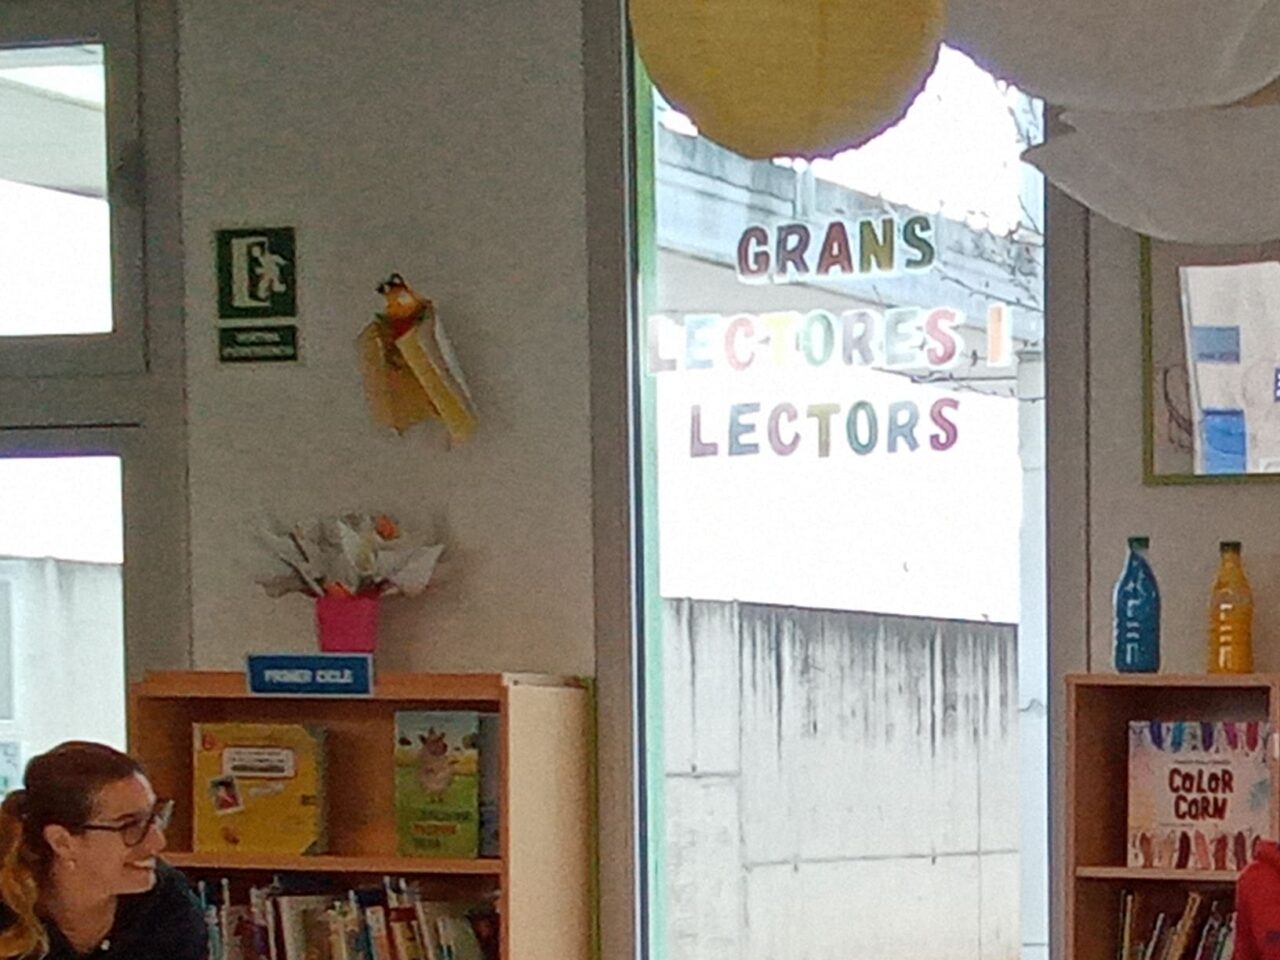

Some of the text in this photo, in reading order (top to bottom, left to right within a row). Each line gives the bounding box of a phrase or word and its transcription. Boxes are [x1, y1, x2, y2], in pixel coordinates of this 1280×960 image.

[737, 215, 936, 278] GRANS
[647, 308, 957, 372] LECTORES
[689, 398, 960, 459] LECTORS
[1168, 767, 1235, 794] COLOR
[1174, 794, 1229, 821] CORN
